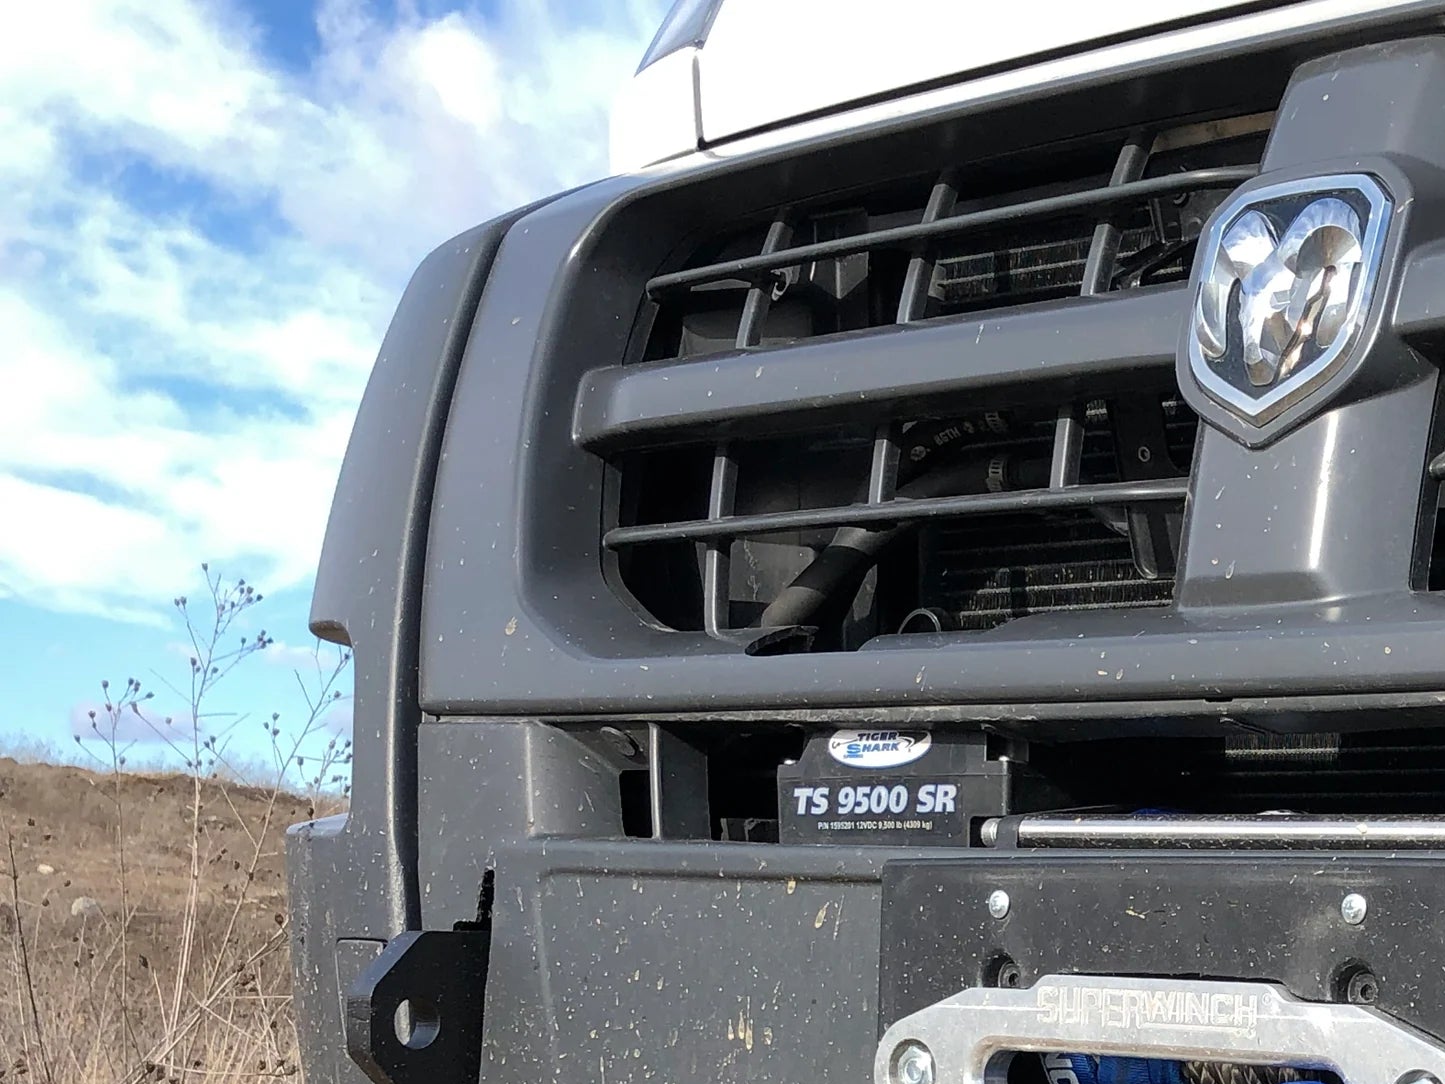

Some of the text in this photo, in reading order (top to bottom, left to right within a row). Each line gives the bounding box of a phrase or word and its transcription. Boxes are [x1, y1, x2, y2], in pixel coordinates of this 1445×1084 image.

[857, 732, 898, 741] TIGER
[846, 743, 901, 754] SHARK
[793, 783, 958, 815] TS 9500 SR
[856, 820, 878, 830] 12VDC
[1036, 985, 1258, 1031] SUPERWINCH
